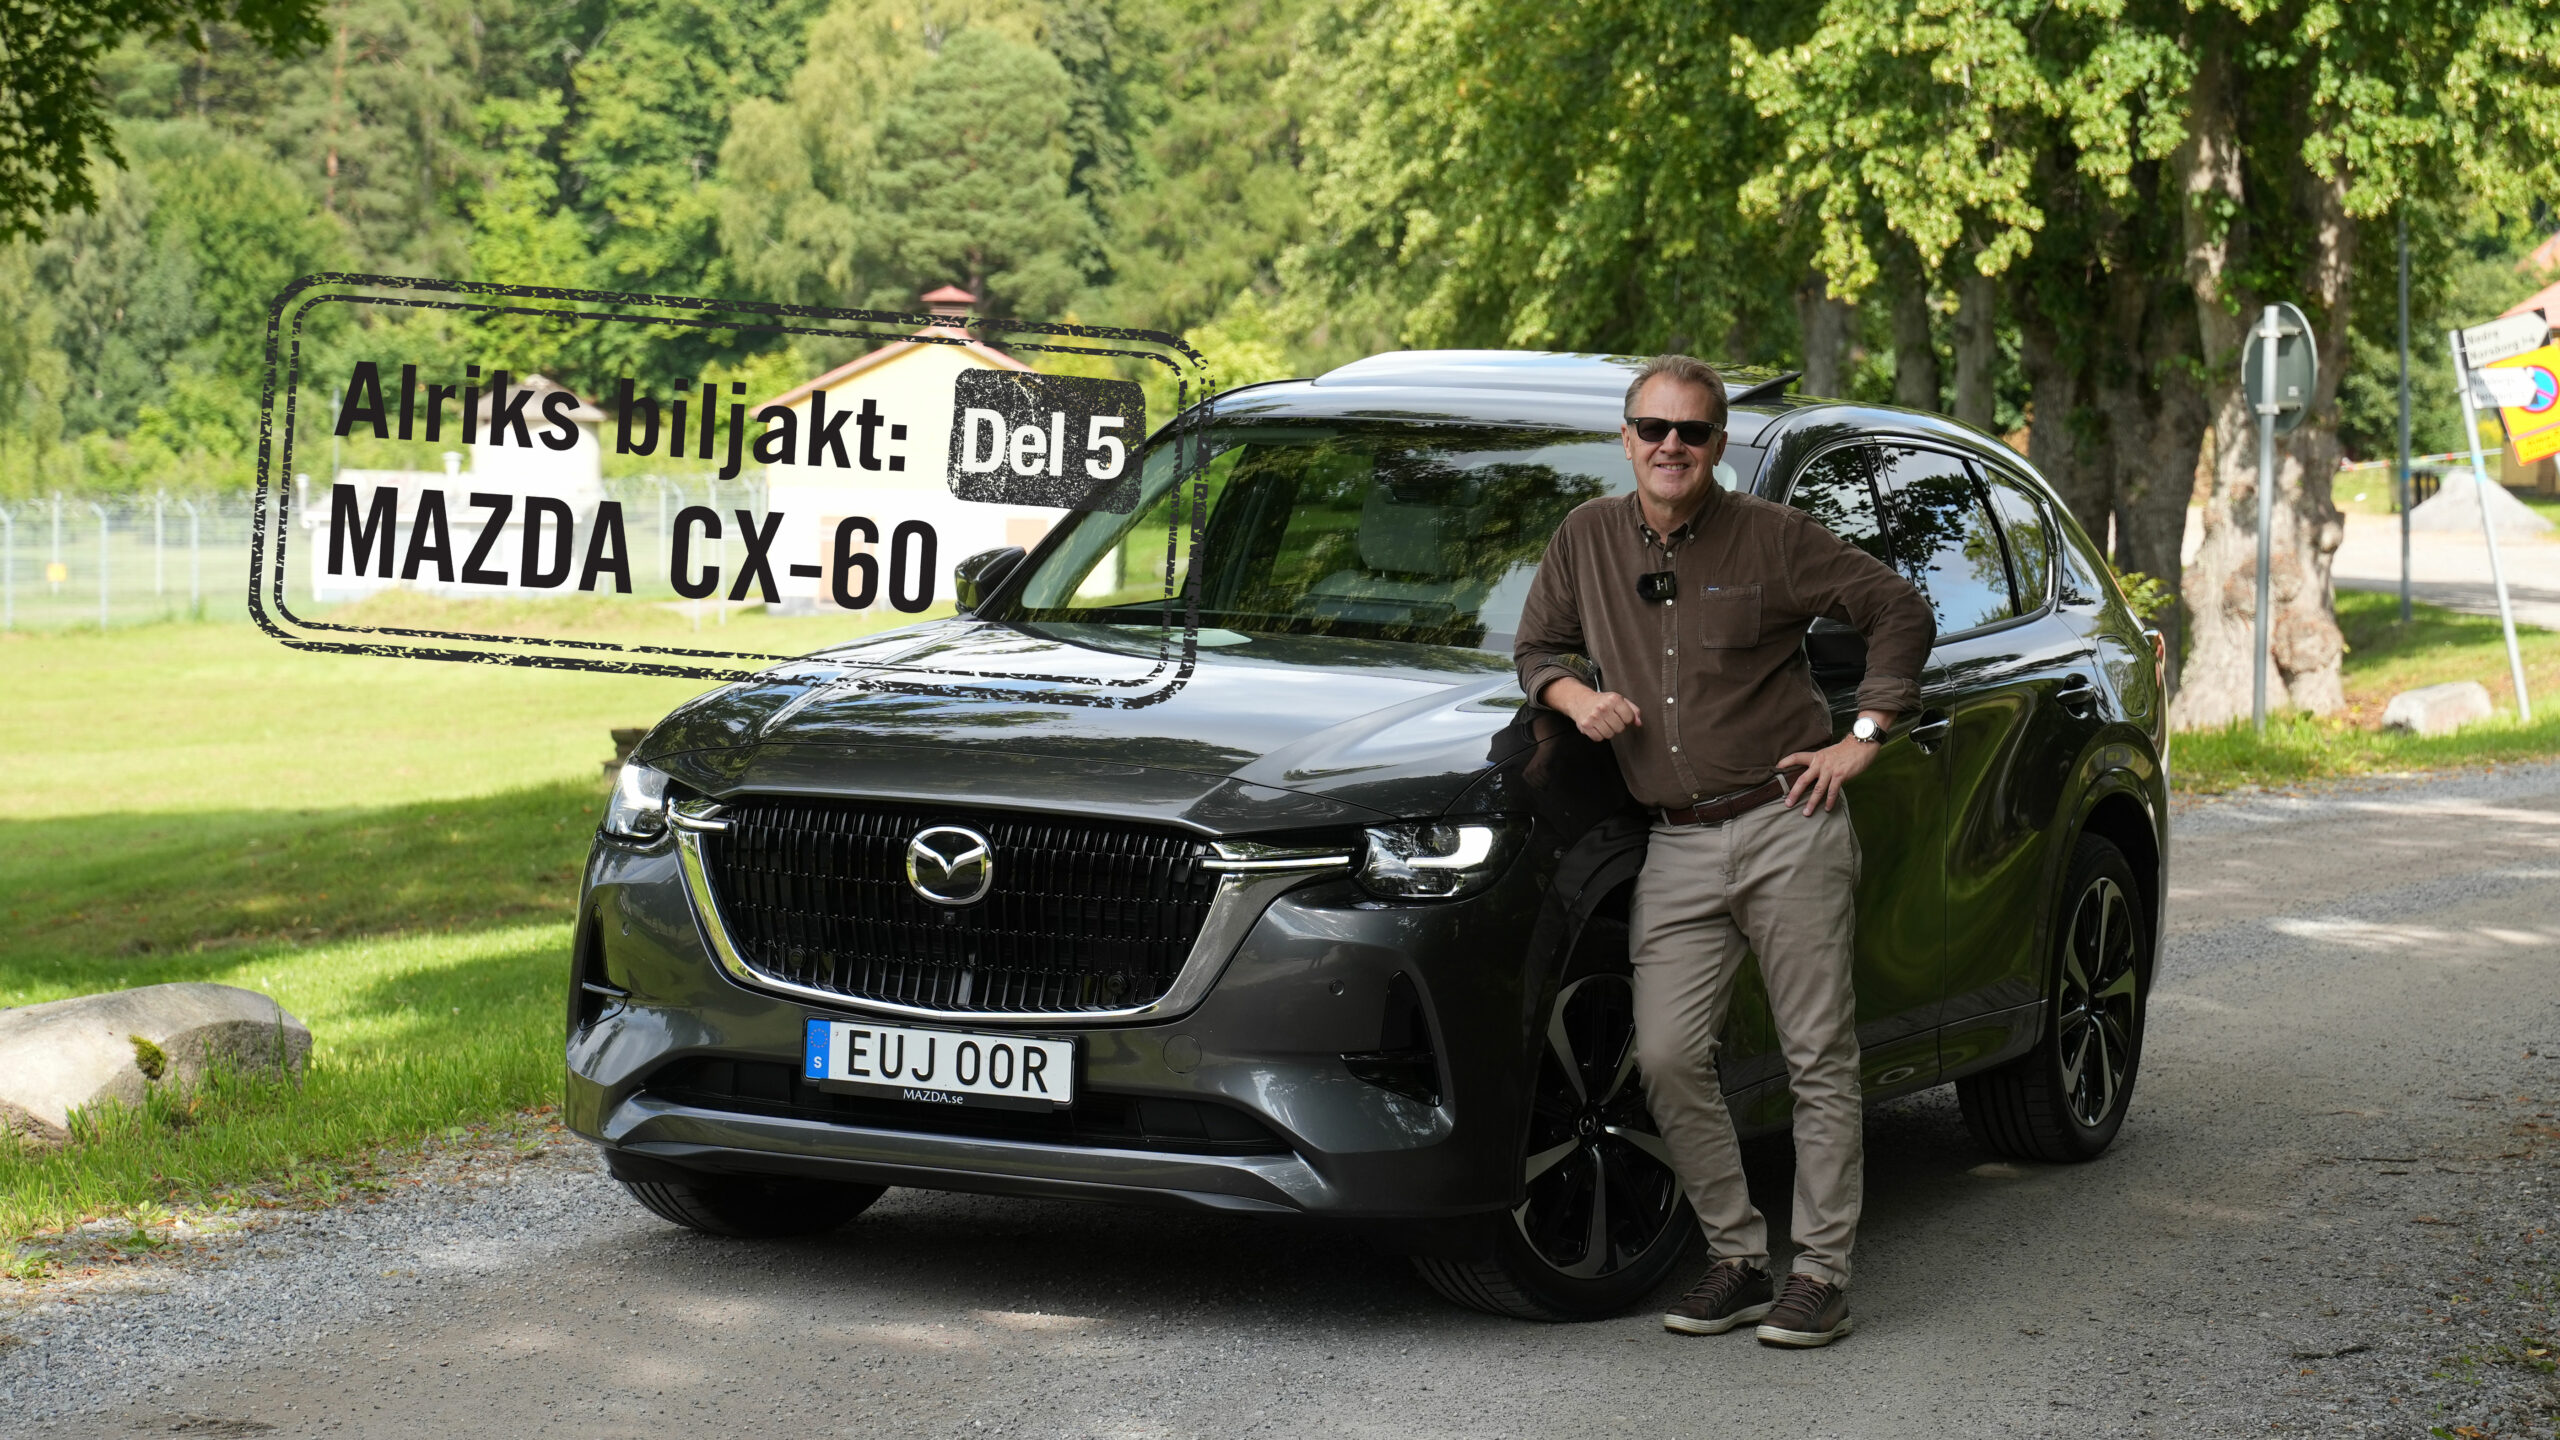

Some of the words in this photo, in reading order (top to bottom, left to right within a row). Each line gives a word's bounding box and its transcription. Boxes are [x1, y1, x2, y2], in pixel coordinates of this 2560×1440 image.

[813, 1056, 822, 1069] S
[847, 1029, 936, 1082] EUJ
[903, 1088, 964, 1105] MAZDA.se
